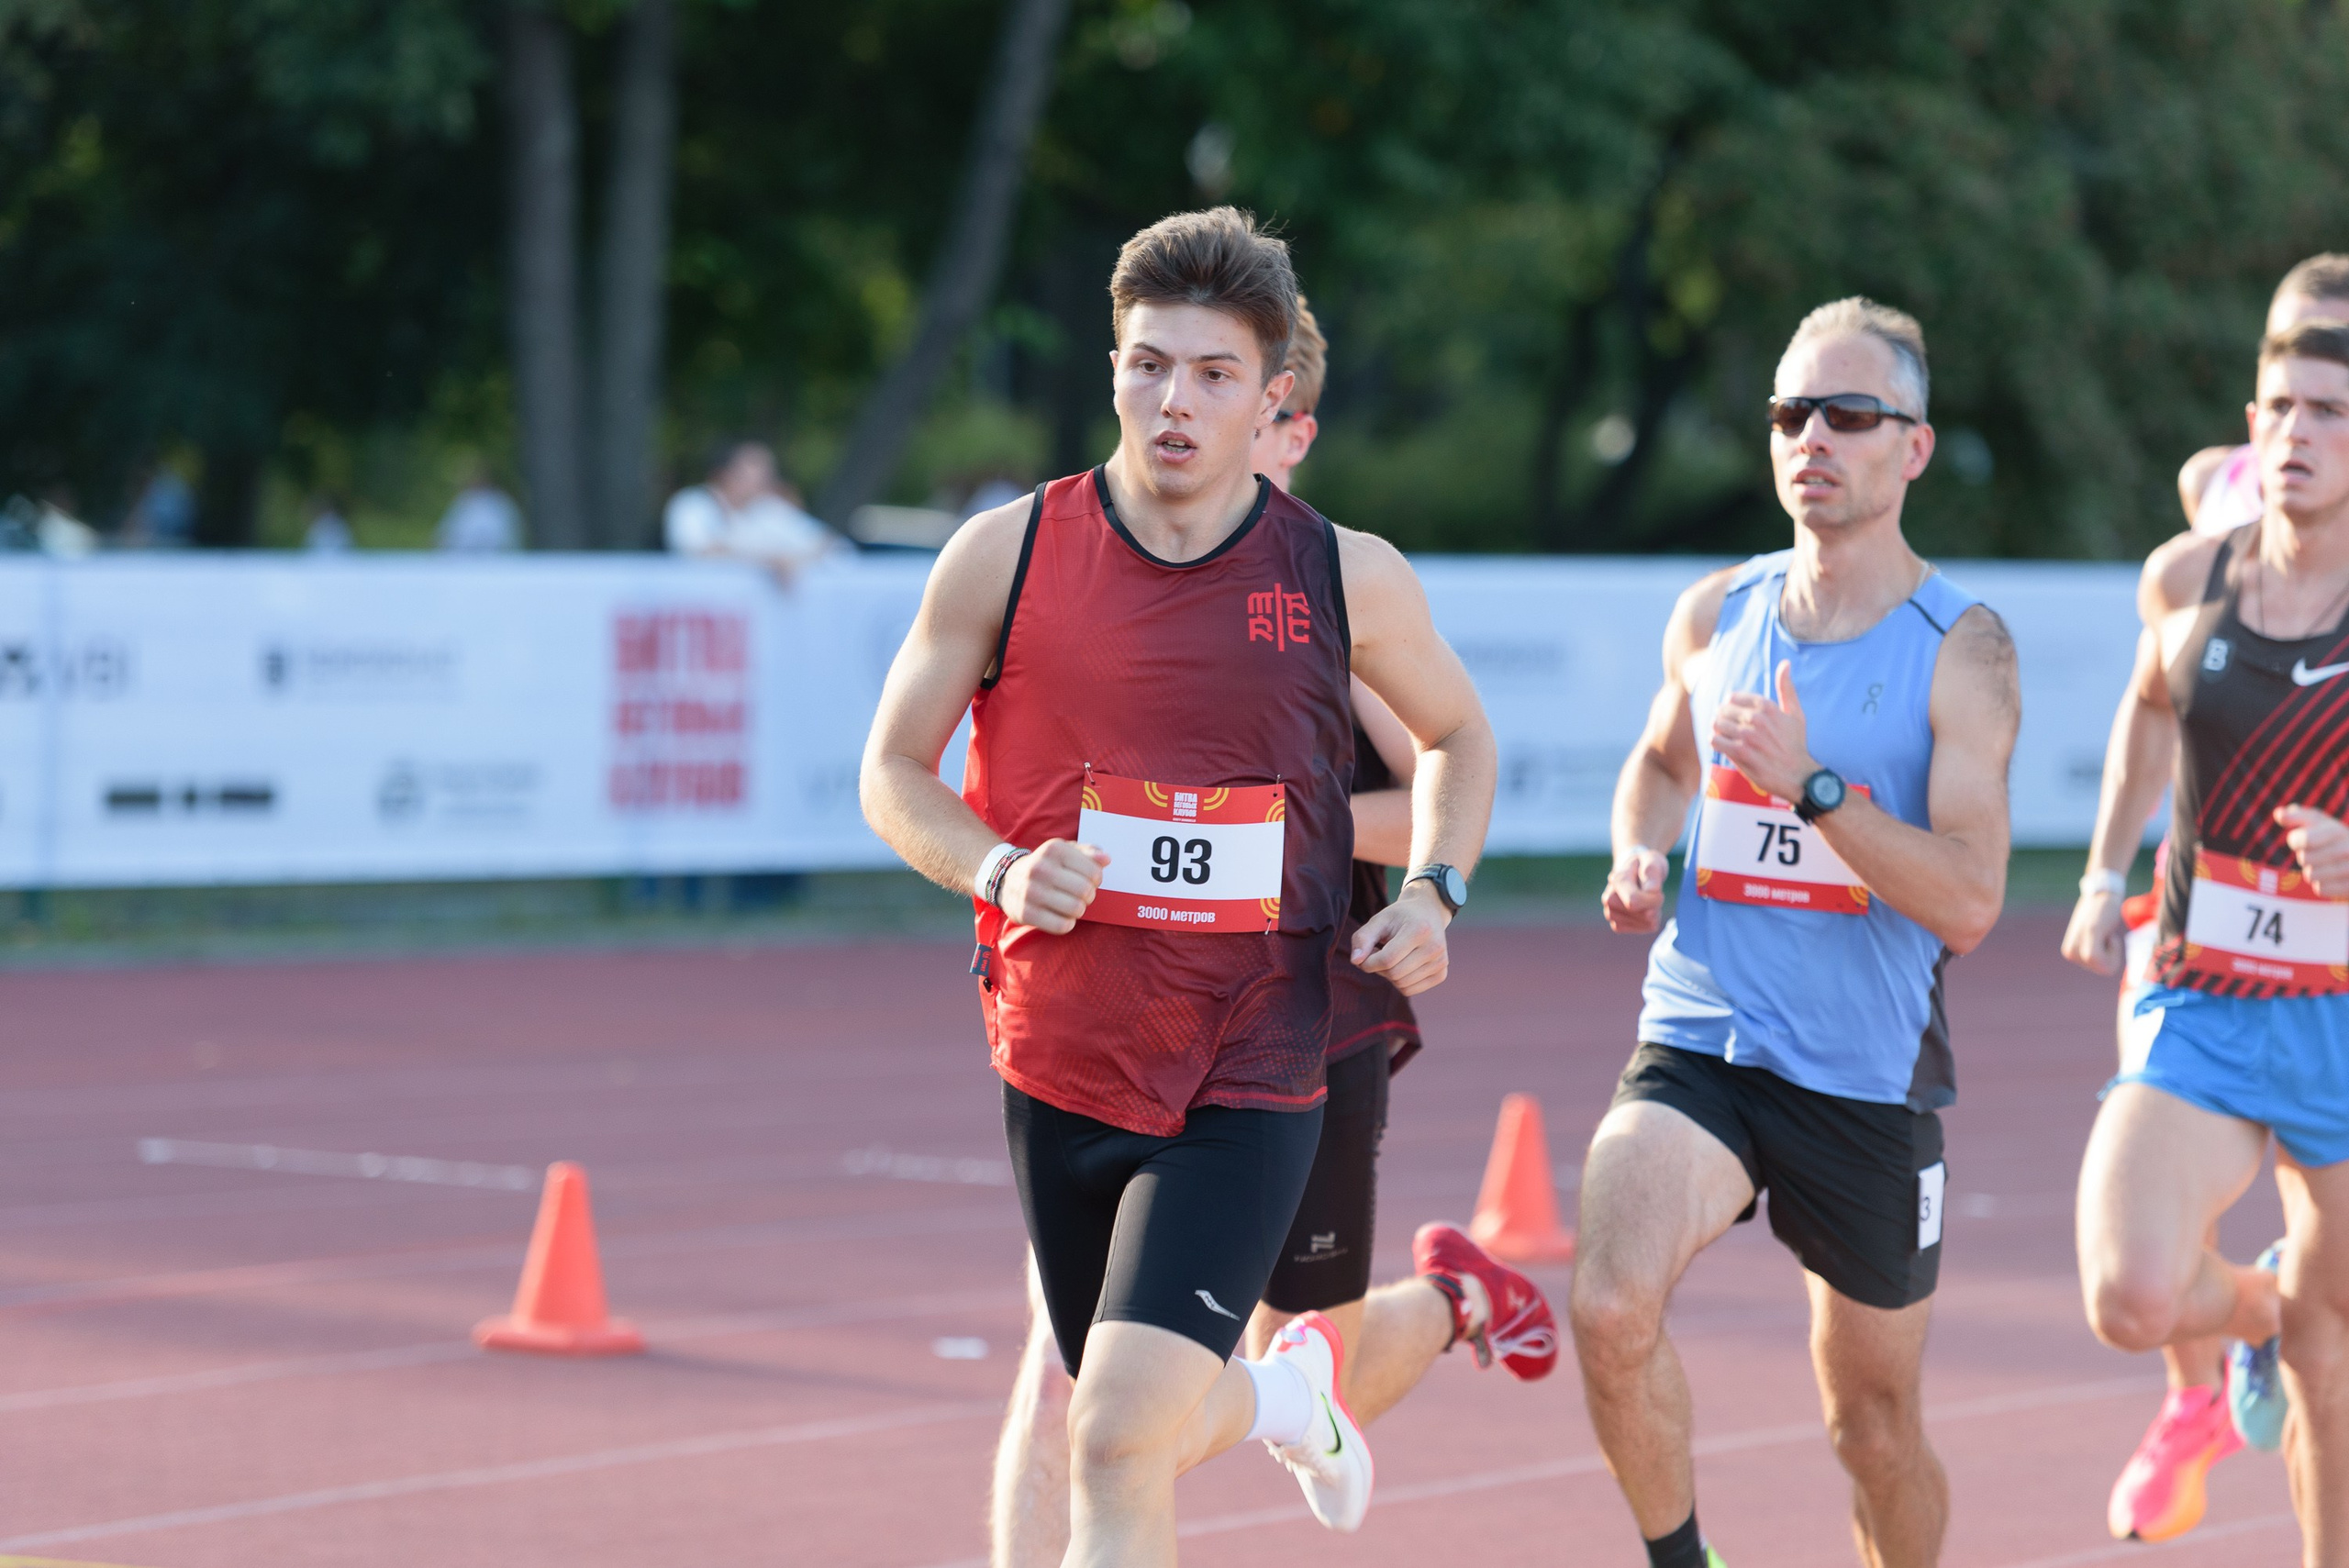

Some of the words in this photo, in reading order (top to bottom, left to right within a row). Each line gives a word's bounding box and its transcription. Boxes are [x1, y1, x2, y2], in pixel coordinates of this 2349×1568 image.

[1151, 836, 1212, 884] 93
[1757, 822, 1800, 865] 75
[1137, 906, 1168, 920] 3000
[1170, 909, 1215, 924] метров
[2247, 904, 2283, 944] 74
